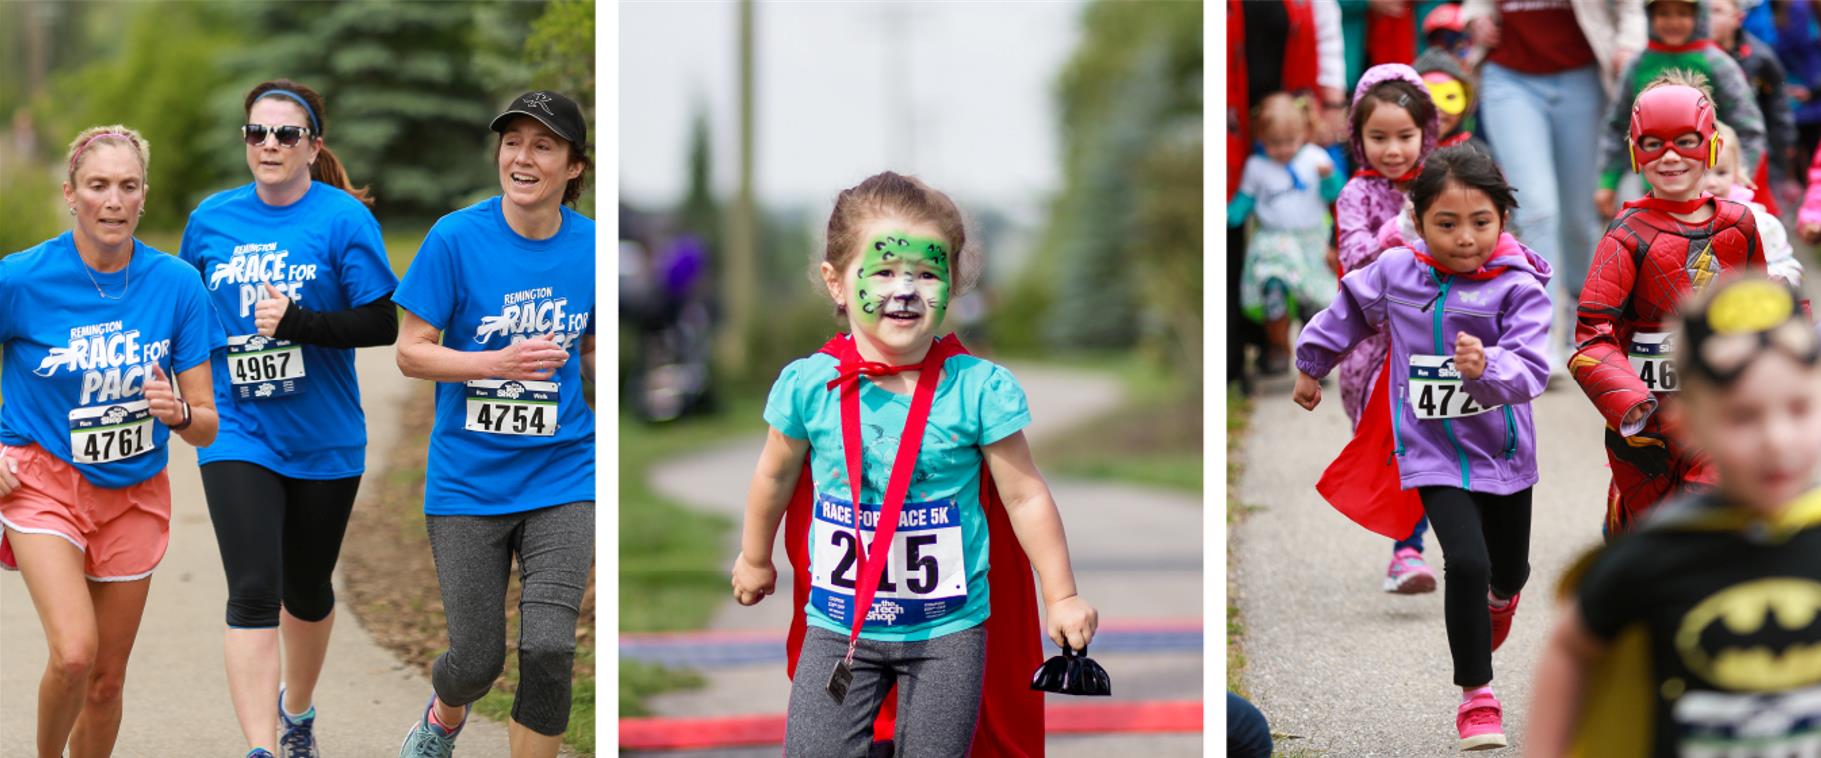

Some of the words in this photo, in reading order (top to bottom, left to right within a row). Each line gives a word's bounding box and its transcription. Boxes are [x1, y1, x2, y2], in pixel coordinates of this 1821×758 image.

[227, 249, 289, 284] RACE
[288, 264, 317, 281] FOR
[504, 287, 553, 304] REMINGTON
[70, 320, 122, 339] REMINGTON
[501, 297, 568, 337] RACE
[568, 312, 589, 332] FOR
[66, 329, 141, 372] RACE
[143, 339, 171, 362] FOR
[236, 352, 291, 381] 4967
[1418, 384, 1489, 416] 472
[477, 403, 546, 434] 4754
[84, 425, 144, 461] 4761
[822, 501, 852, 524] RACE
[898, 508, 927, 528] ACE
[930, 507, 950, 524] 5K
[872, 603, 904, 614] Tech
